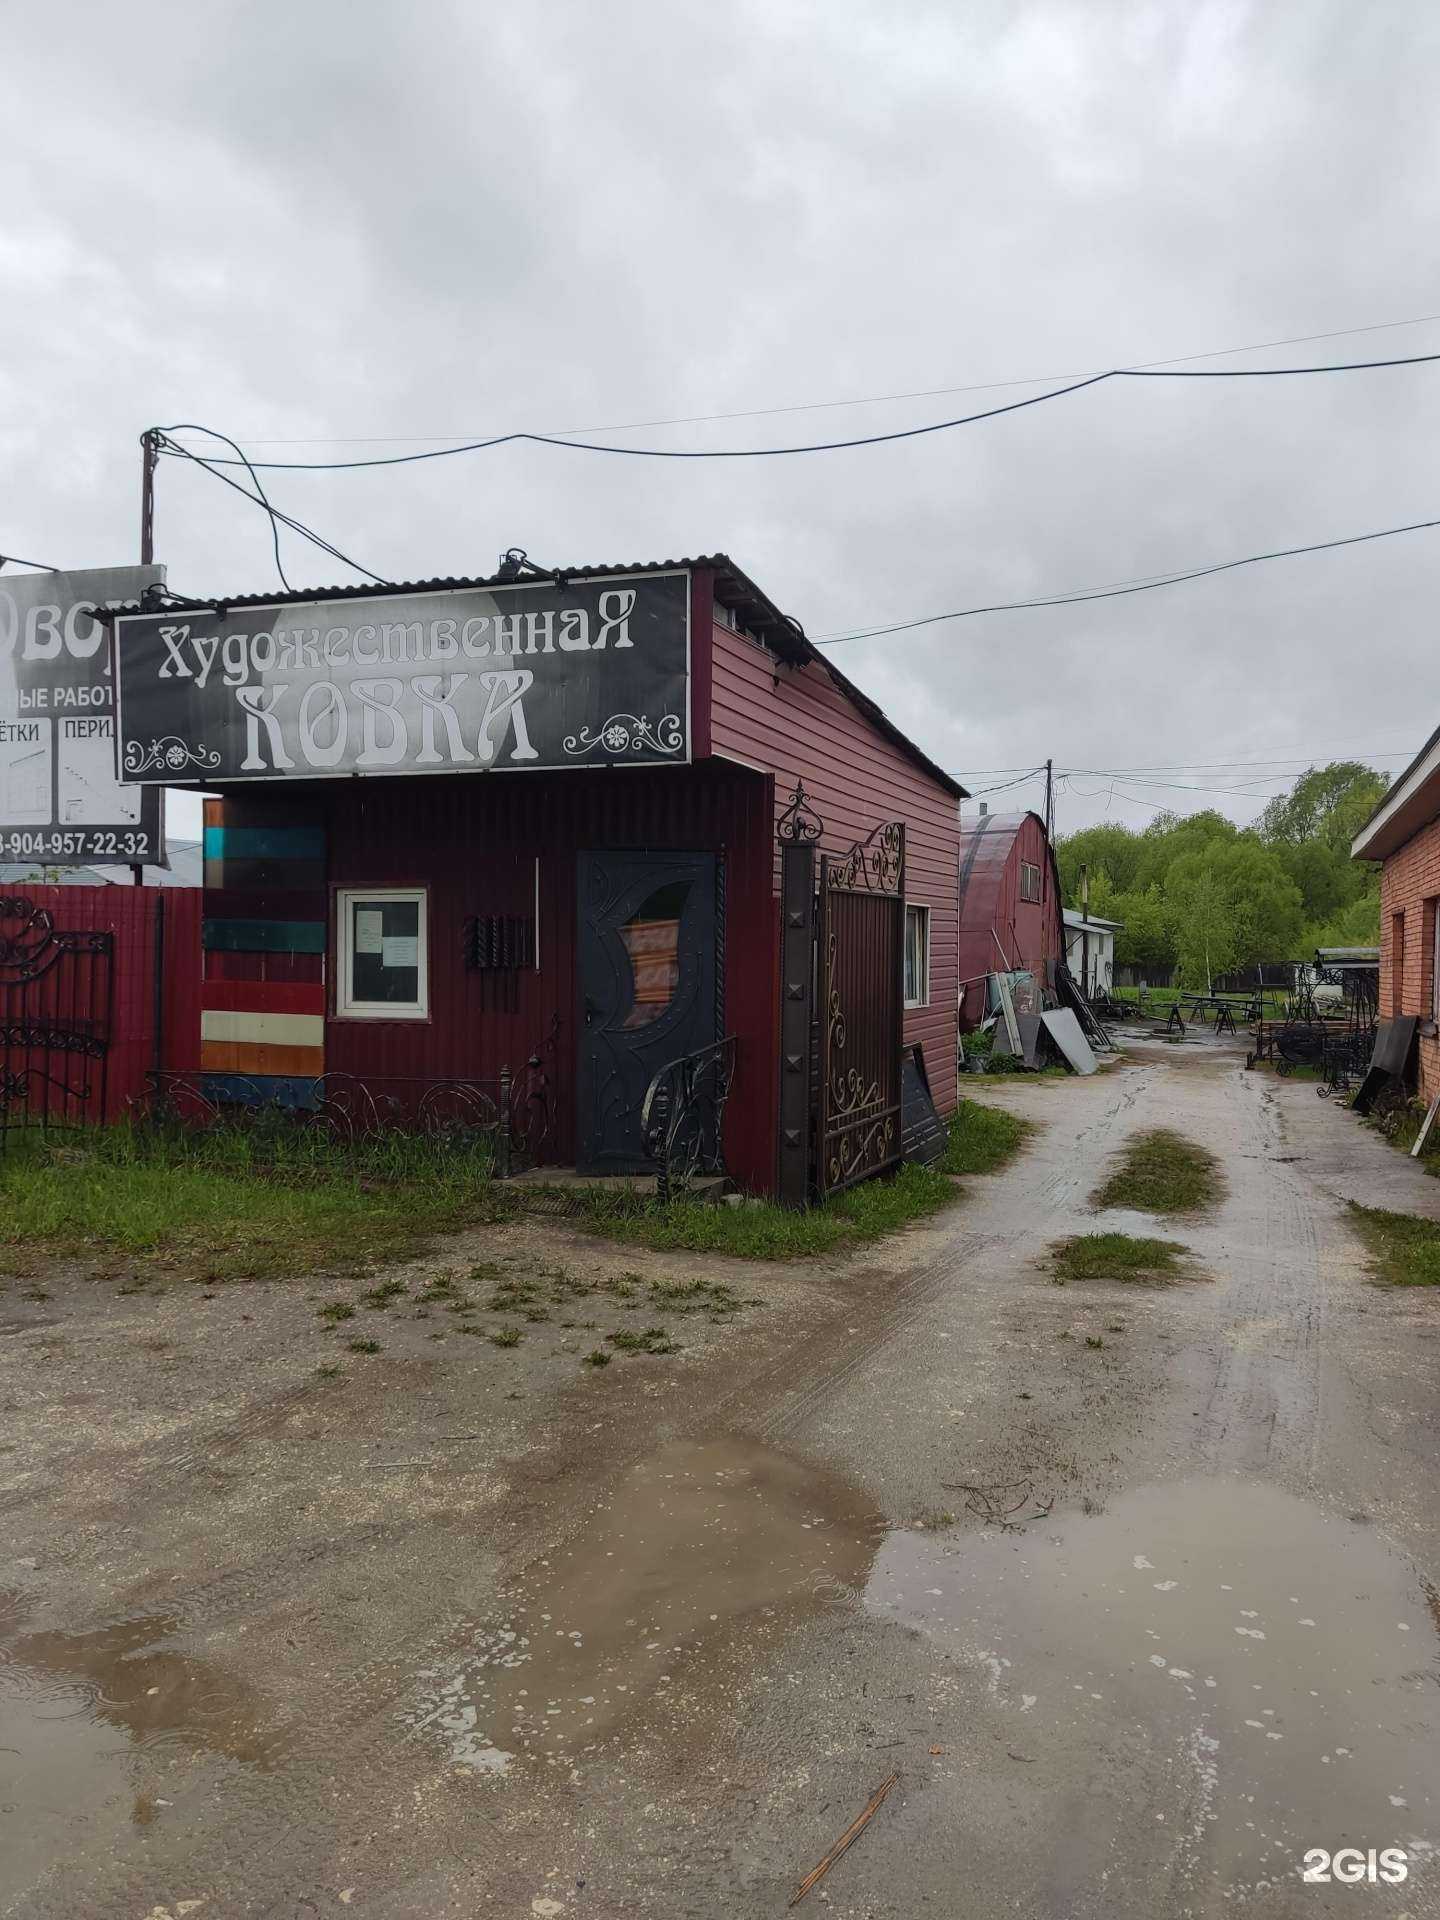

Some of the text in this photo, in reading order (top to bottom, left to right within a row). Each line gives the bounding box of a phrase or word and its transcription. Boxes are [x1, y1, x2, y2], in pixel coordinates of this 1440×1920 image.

[17, 687, 48, 709] ЫЕ
[65, 719, 114, 738] ПЕРИ
[235, 669, 539, 770] КОВКА
